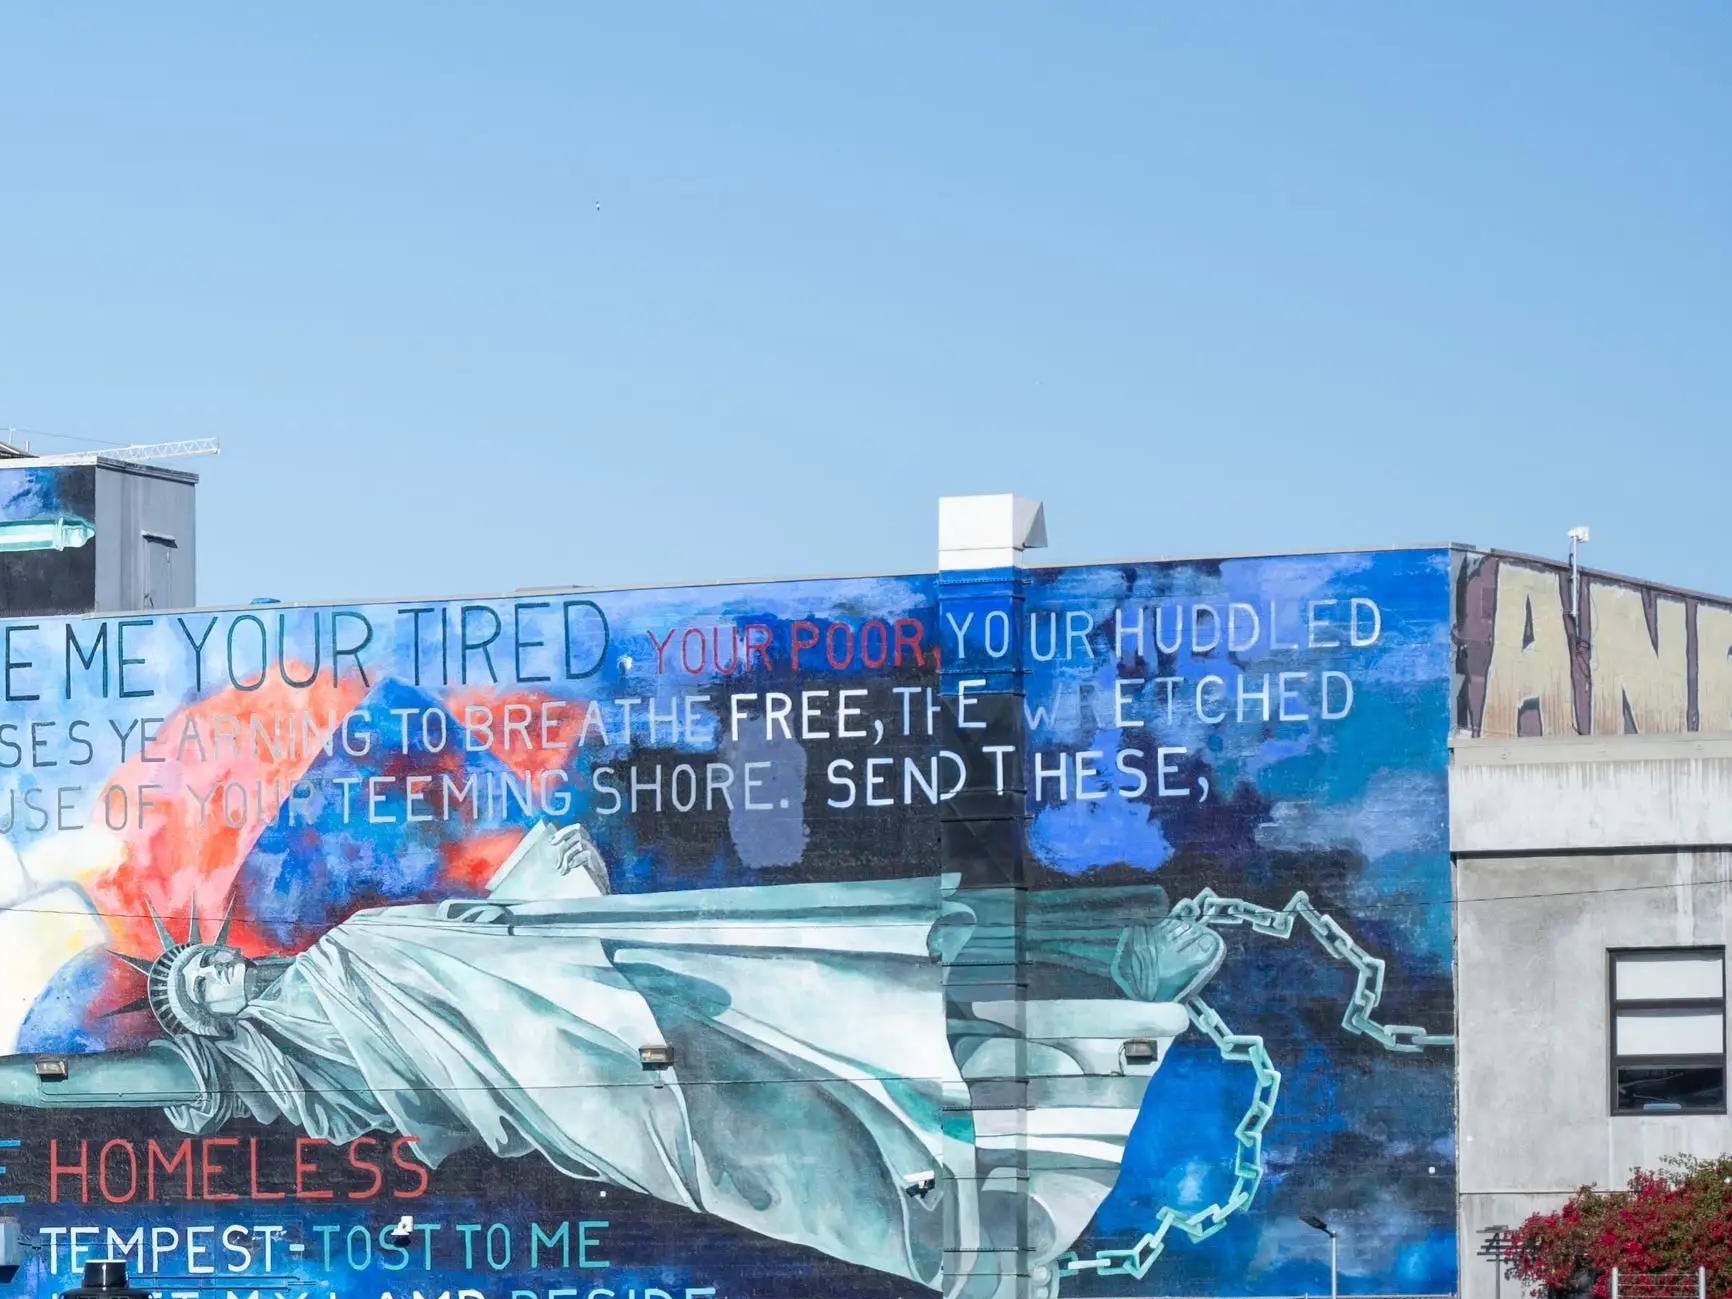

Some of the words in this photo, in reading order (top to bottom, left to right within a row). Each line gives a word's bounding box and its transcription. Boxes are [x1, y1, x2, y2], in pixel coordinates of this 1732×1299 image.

[65, 620, 154, 700] ME
[177, 611, 370, 692] YOUR
[646, 623, 773, 675] YOUR
[791, 618, 941, 673] POOR,
[946, 610, 1094, 662] YOUR
[1115, 597, 1382, 658] HUDDLED
[109, 709, 373, 764] YEARNING
[390, 707, 447, 754] TO
[465, 695, 711, 752] BREATHE
[730, 688, 884, 745] FREE,
[892, 678, 987, 736] THE
[105, 784, 163, 830] OF
[186, 778, 318, 830] YOUR
[332, 768, 572, 824] TEEMING
[592, 760, 790, 815] SHORE.
[827, 750, 967, 808] SEND
[982, 745, 1210, 802] THESE,
[49, 1136, 430, 1204] HOMELESS
[454, 1223, 513, 1271] TO
[530, 1221, 610, 1269] ME
